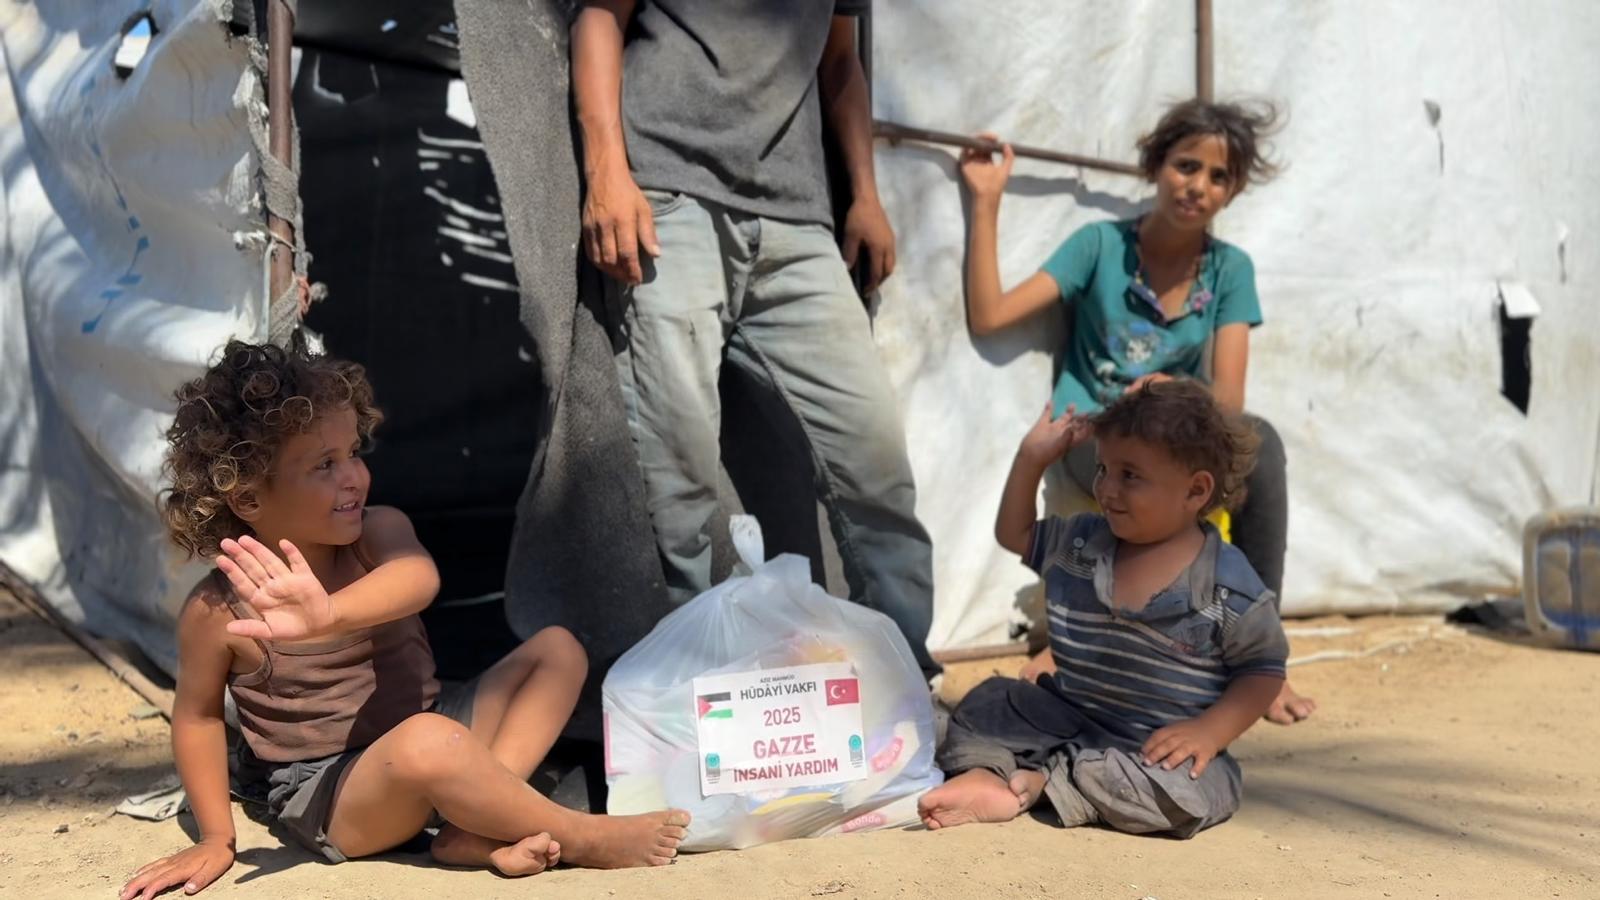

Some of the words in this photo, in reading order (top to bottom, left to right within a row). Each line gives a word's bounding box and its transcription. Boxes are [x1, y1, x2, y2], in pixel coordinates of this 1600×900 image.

[784, 681, 817, 695] VAKFI
[763, 706, 801, 726] 2025
[753, 734, 816, 759] GAZZE
[785, 758, 839, 778] YARDIM
